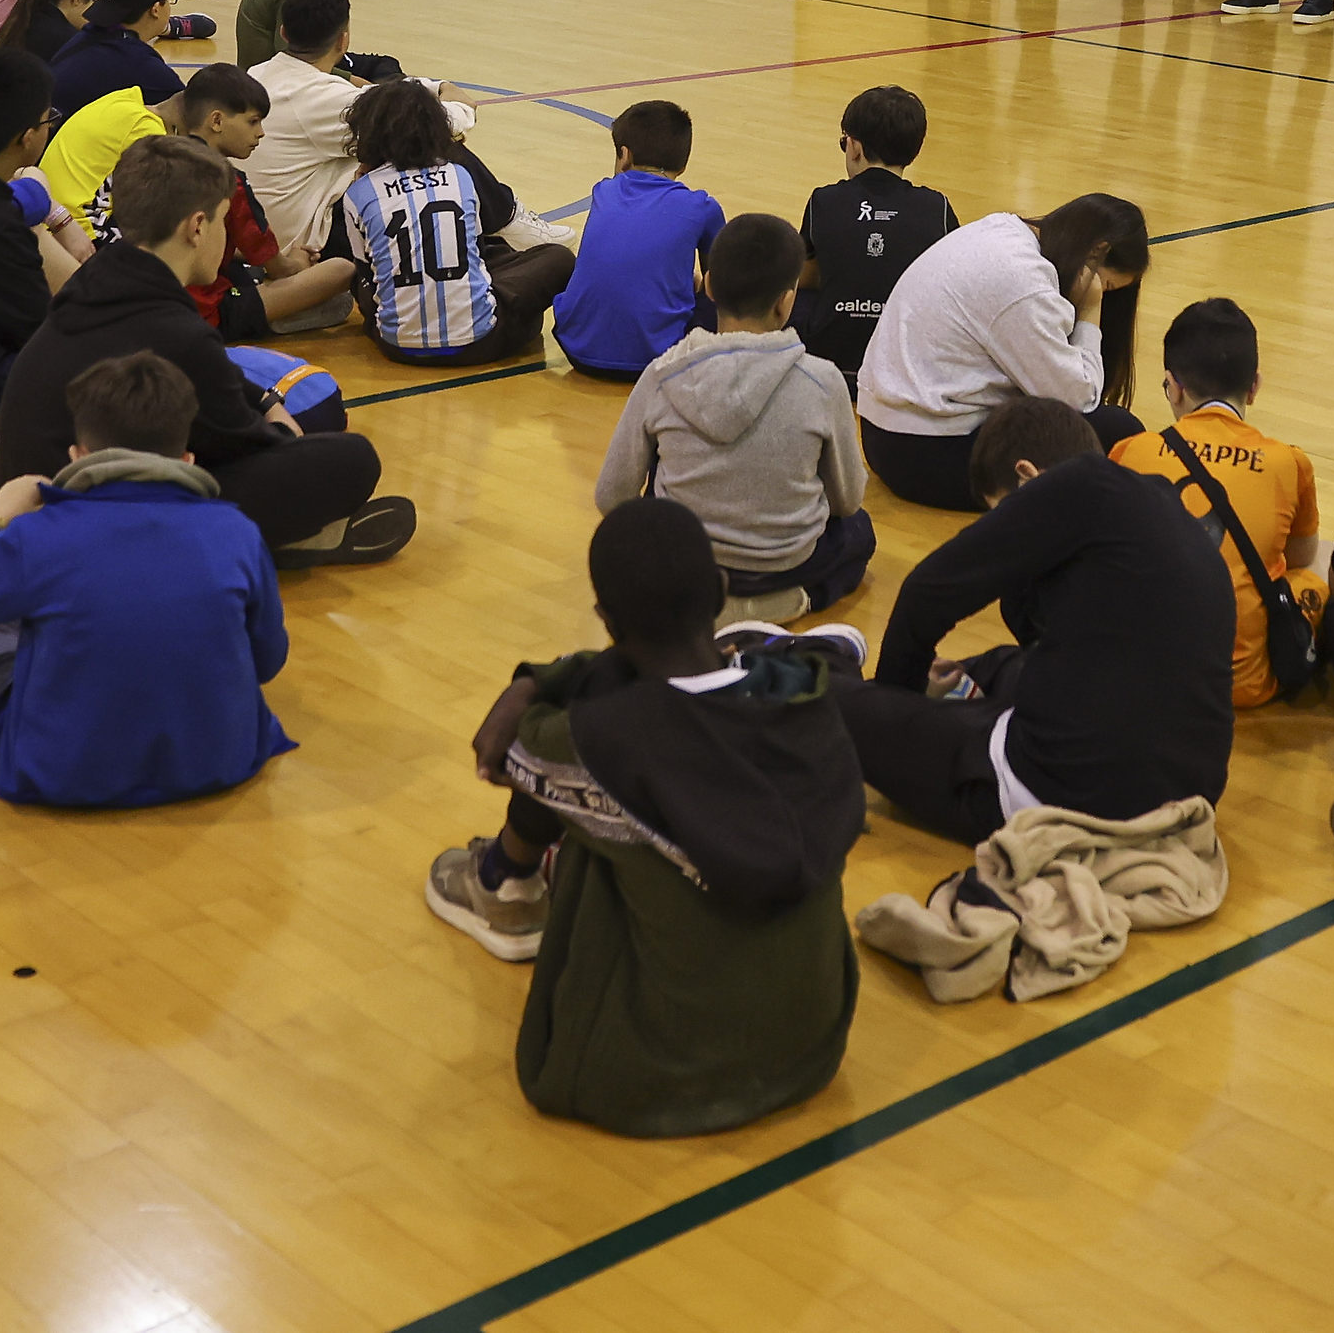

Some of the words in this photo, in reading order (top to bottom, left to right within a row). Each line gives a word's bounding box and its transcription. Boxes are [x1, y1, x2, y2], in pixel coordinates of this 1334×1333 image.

[384, 171, 449, 198] MESSI
[384, 200, 469, 288] 10
[835, 299, 884, 313] calde
